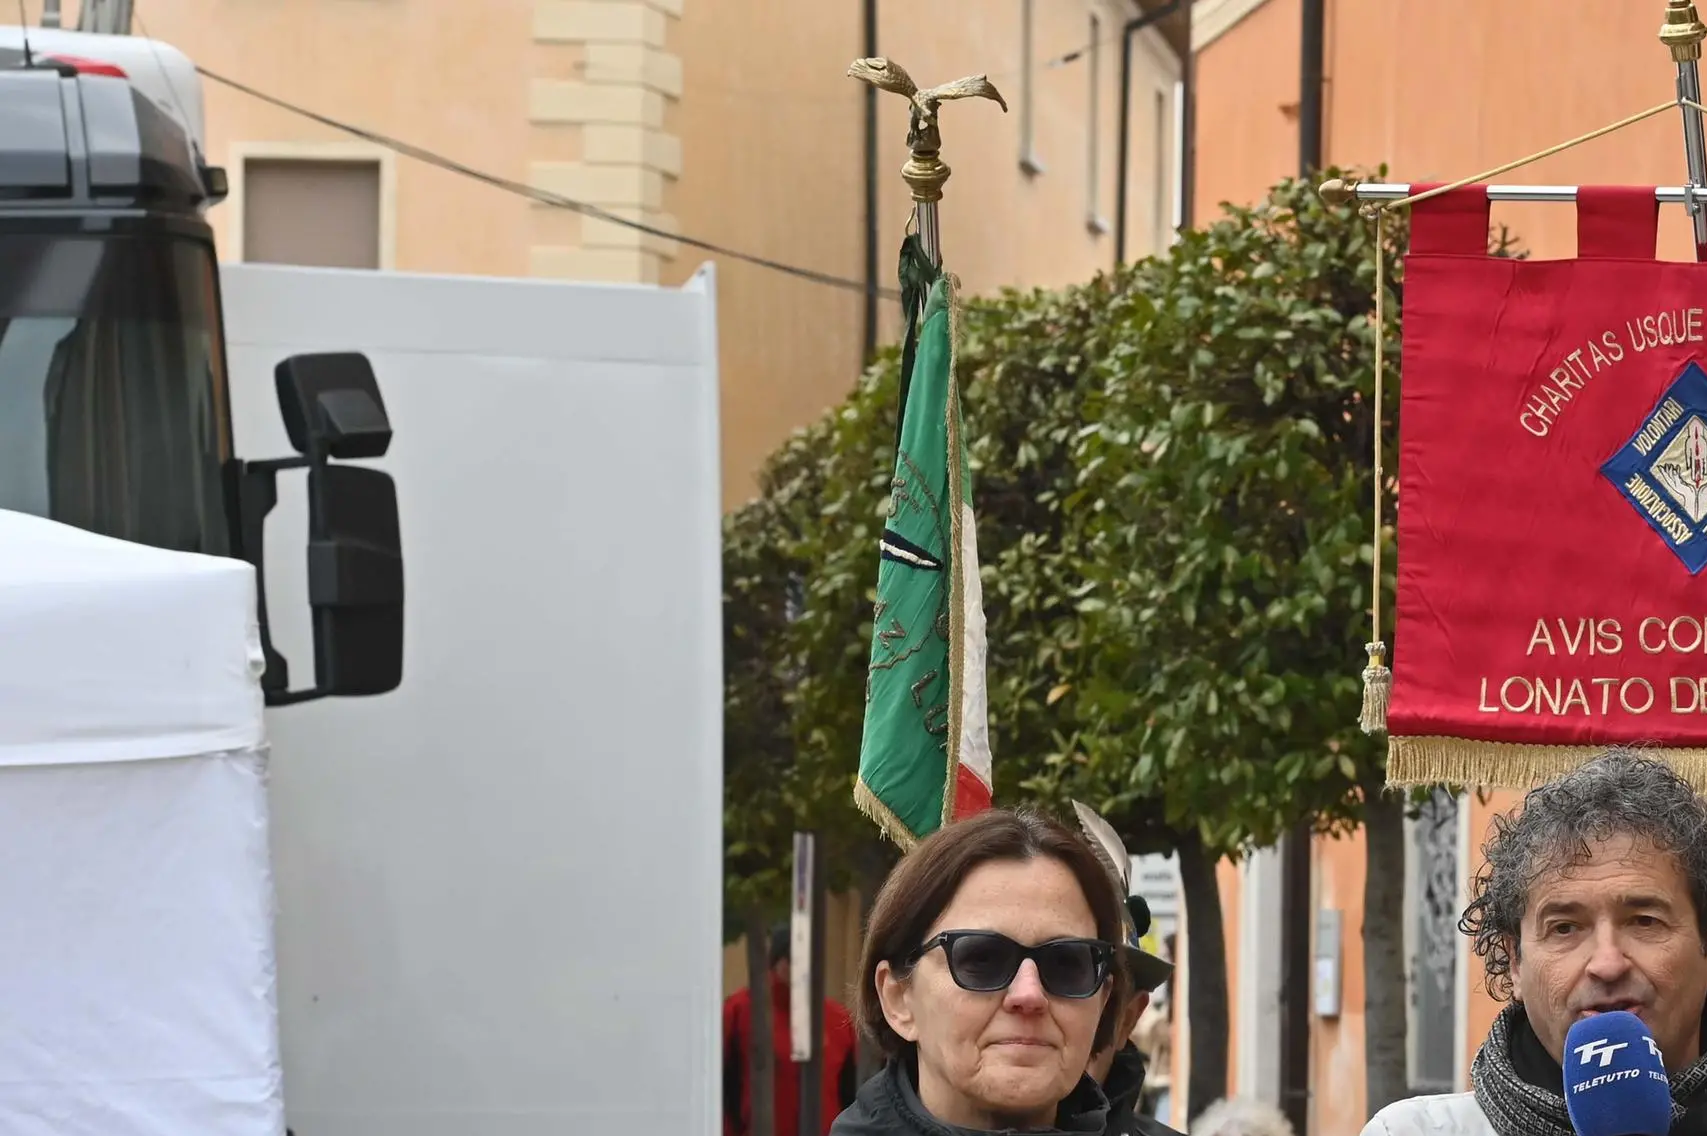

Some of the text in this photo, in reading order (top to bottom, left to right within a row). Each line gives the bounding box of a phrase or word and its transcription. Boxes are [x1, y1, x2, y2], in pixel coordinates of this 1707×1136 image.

[1519, 330, 1624, 438] CHARITAS
[1626, 308, 1703, 352] USQUE
[1632, 397, 1686, 456] VOLONTARI
[1625, 473, 1693, 545] ASSOCIAZIONE
[1526, 618, 1623, 656] AVIS
[1478, 676, 1654, 715] LONATO
[1573, 1068, 1640, 1094] TELETUTTO
